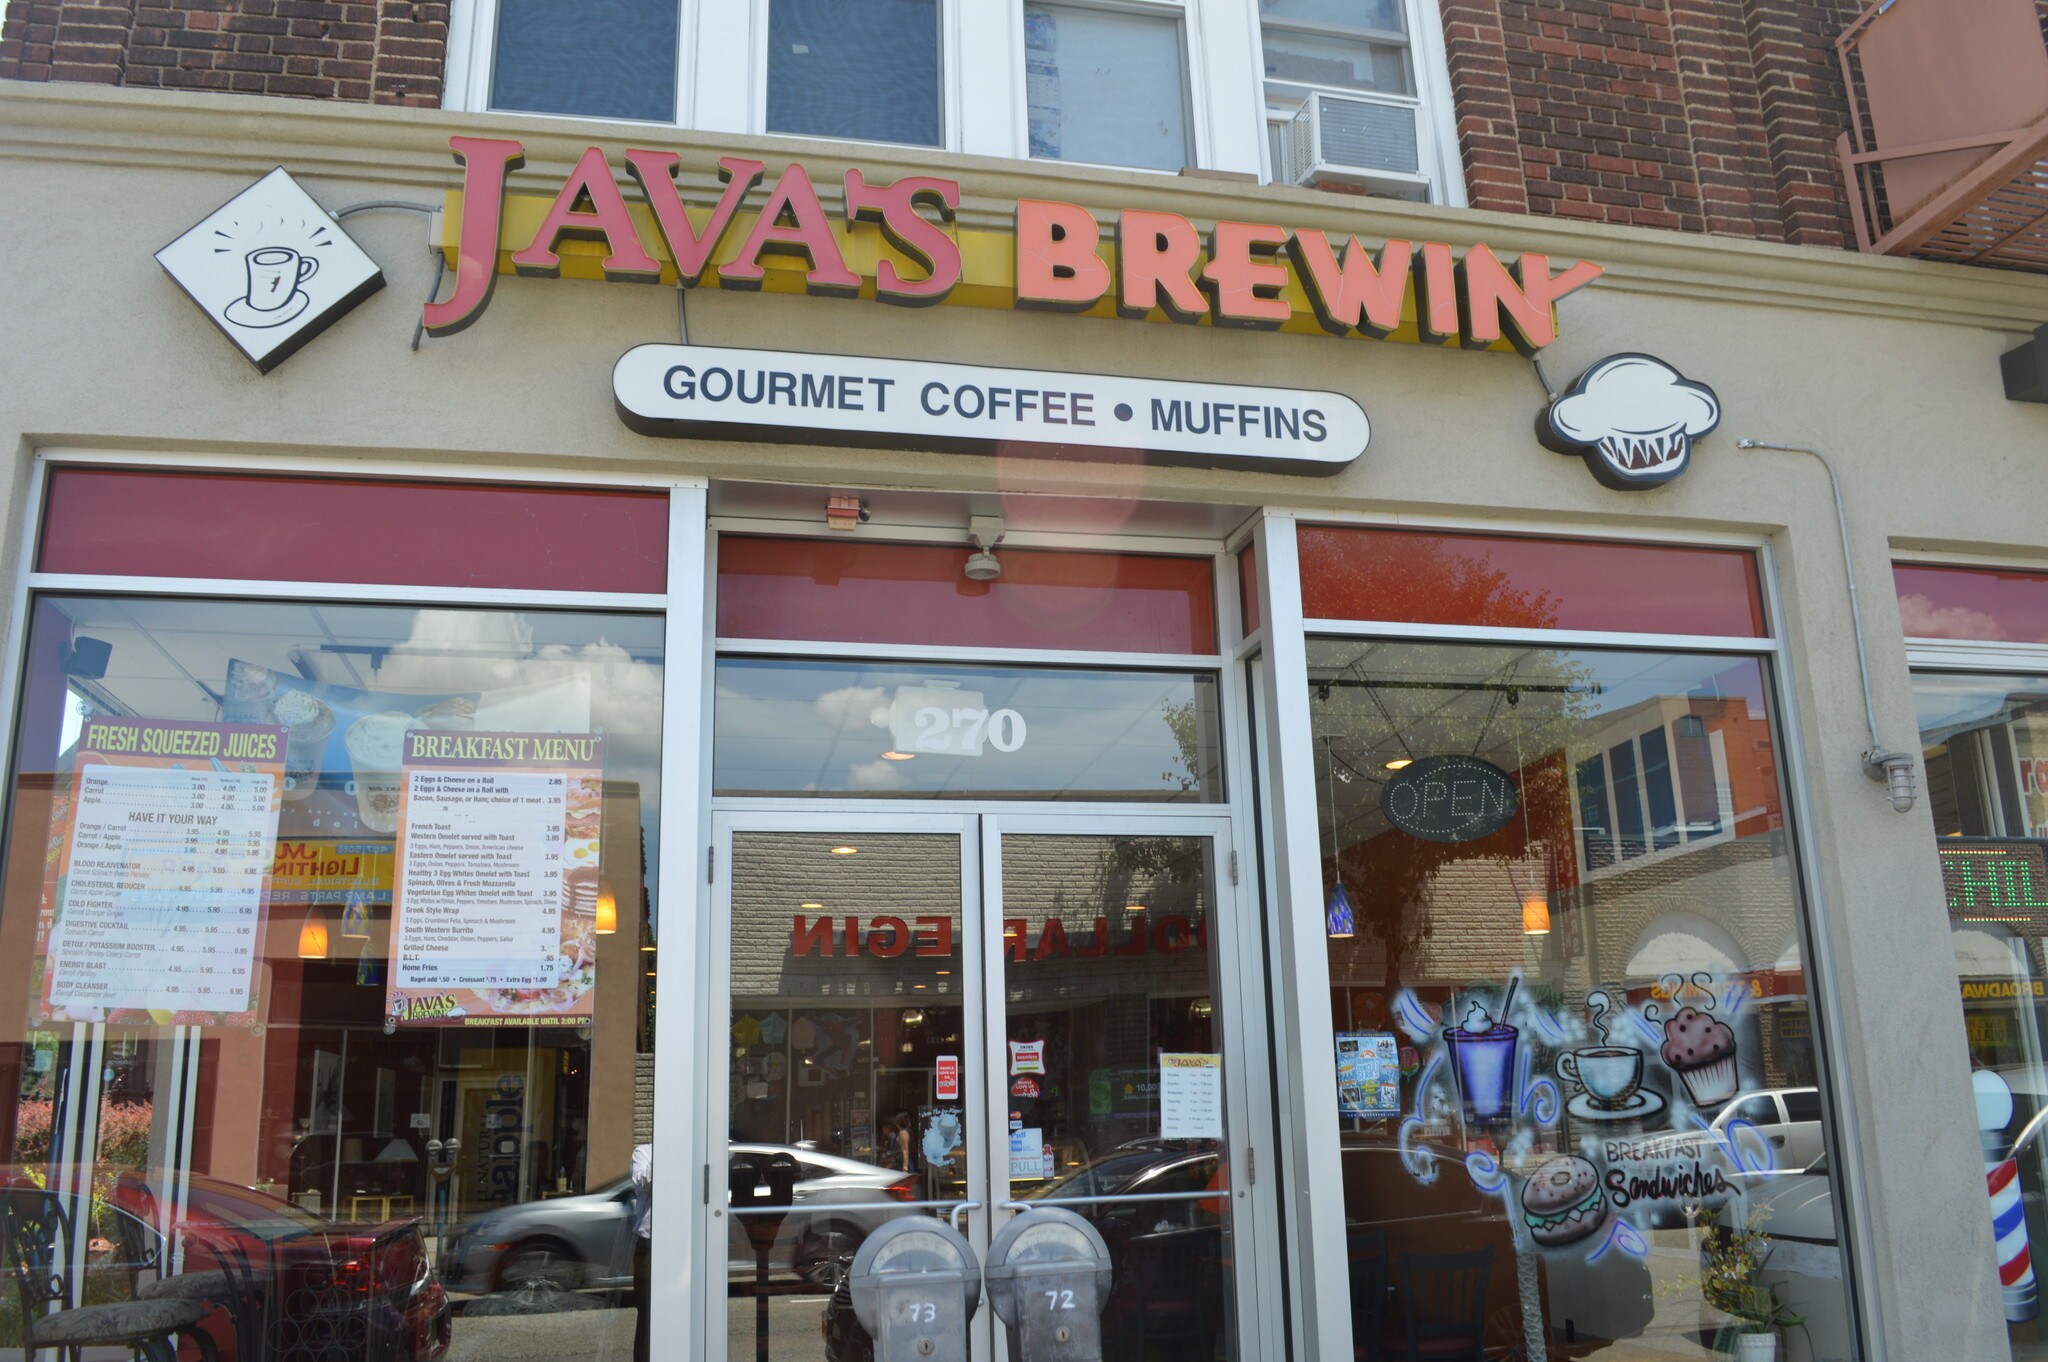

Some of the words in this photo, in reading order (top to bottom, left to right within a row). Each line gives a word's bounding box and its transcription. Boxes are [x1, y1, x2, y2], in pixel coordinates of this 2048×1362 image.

[423, 135, 962, 337] JAVA'S
[663, 364, 895, 413] GOURMET
[920, 382, 1096, 427] COFFEE
[1151, 398, 1328, 442] MUFFINS
[914, 706, 1027, 753] 270
[86, 725, 139, 751] FRESH
[141, 728, 221, 757] SQUEEZED
[223, 732, 277, 759] JUICES
[412, 735, 528, 760] BREAKFAST
[533, 738, 594, 760] MENU
[86, 778, 108, 786] Orange
[1390, 778, 1505, 819] OPEN
[80, 823, 102, 831] Orange
[128, 812, 154, 822] HAVE
[157, 814, 166, 823] IT
[169, 814, 194, 824] YOUR
[196, 816, 218, 826] WAY
[97, 862, 141, 870] REJUVENATOR
[401, 992, 456, 1021] JAVA'S
[464, 1017, 502, 1026] BREAKFAST
[504, 1017, 538, 1025] AVAILABLE
[1605, 1138, 1703, 1162] BREAKFAST
[1011, 1160, 1040, 1172] PULL
[1605, 1161, 1741, 1208] Sandwiches
[1045, 1290, 1076, 1310] 72
[910, 1304, 936, 1323] 73
